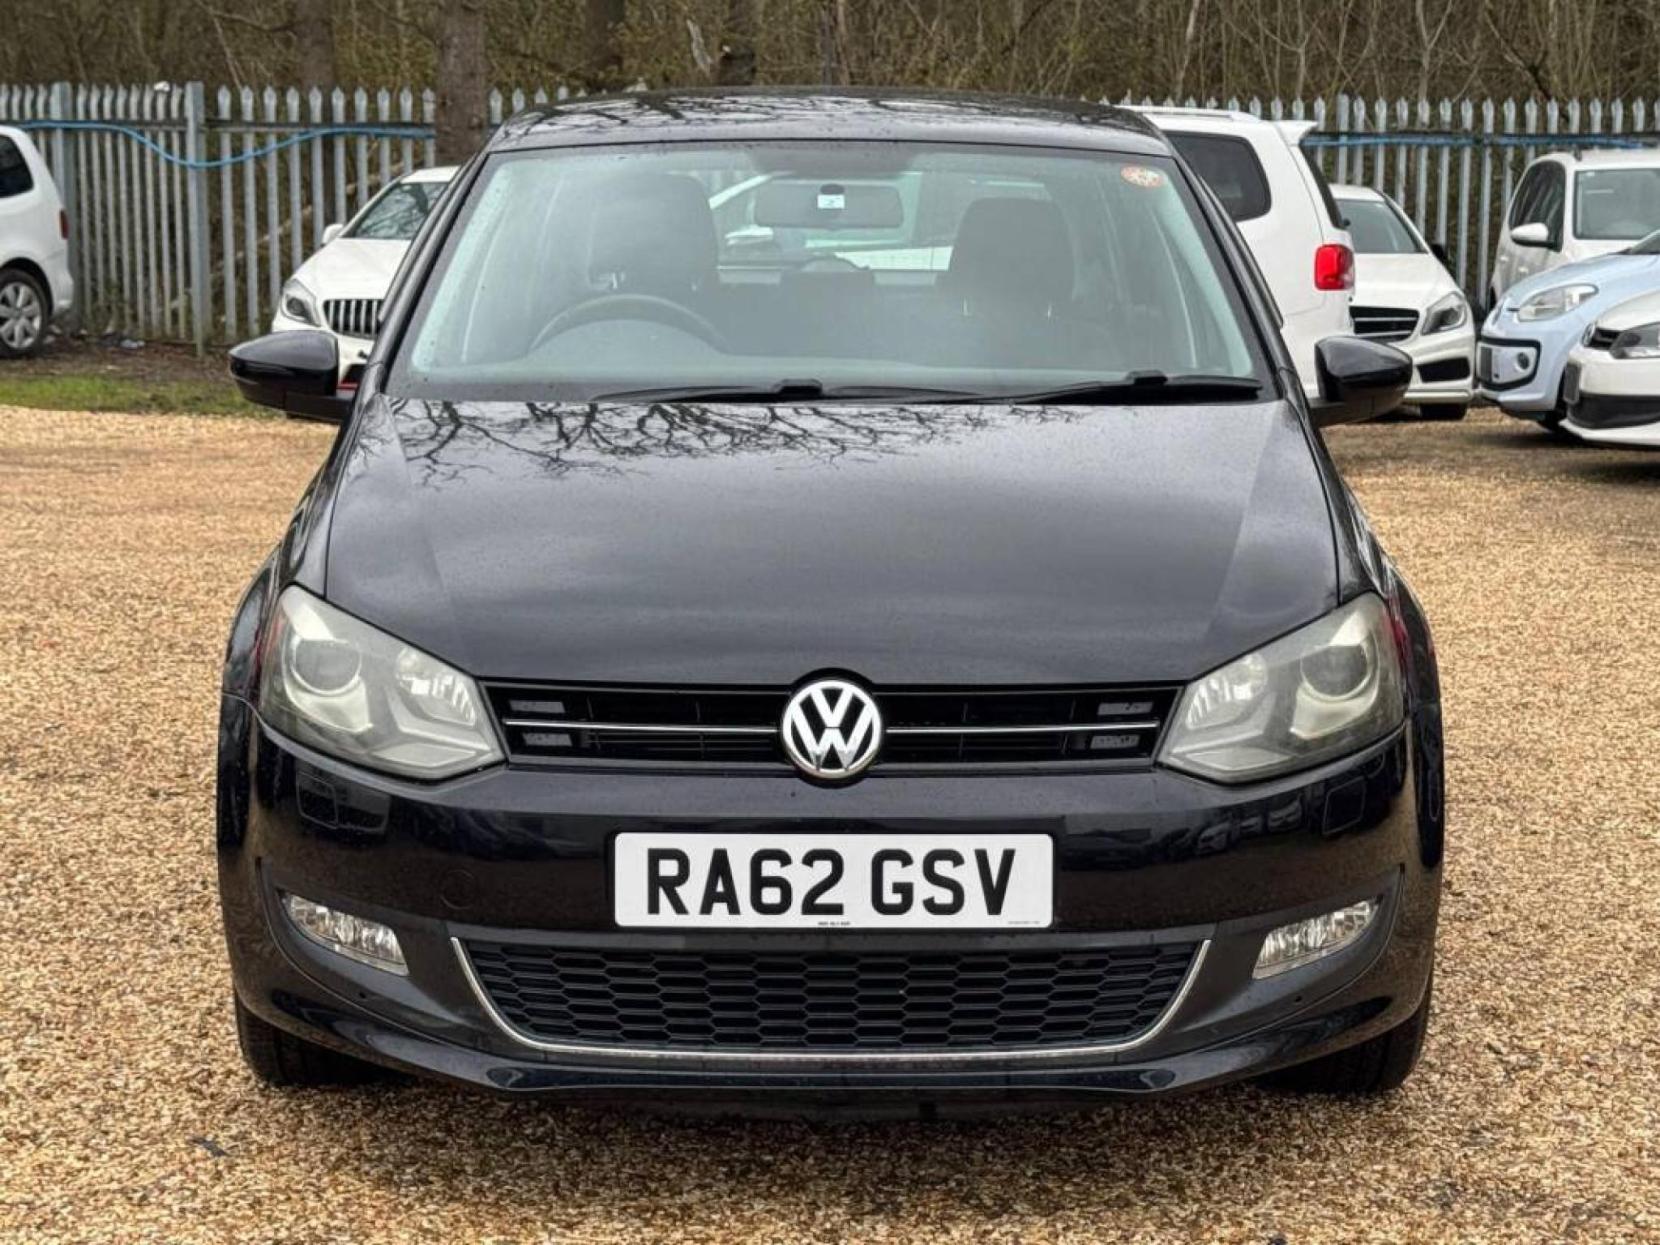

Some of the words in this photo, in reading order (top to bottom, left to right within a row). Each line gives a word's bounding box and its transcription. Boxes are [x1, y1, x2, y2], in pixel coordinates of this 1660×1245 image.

[785, 682, 879, 776] VW
[647, 848, 844, 915] RA62
[871, 848, 1016, 915] GSV
